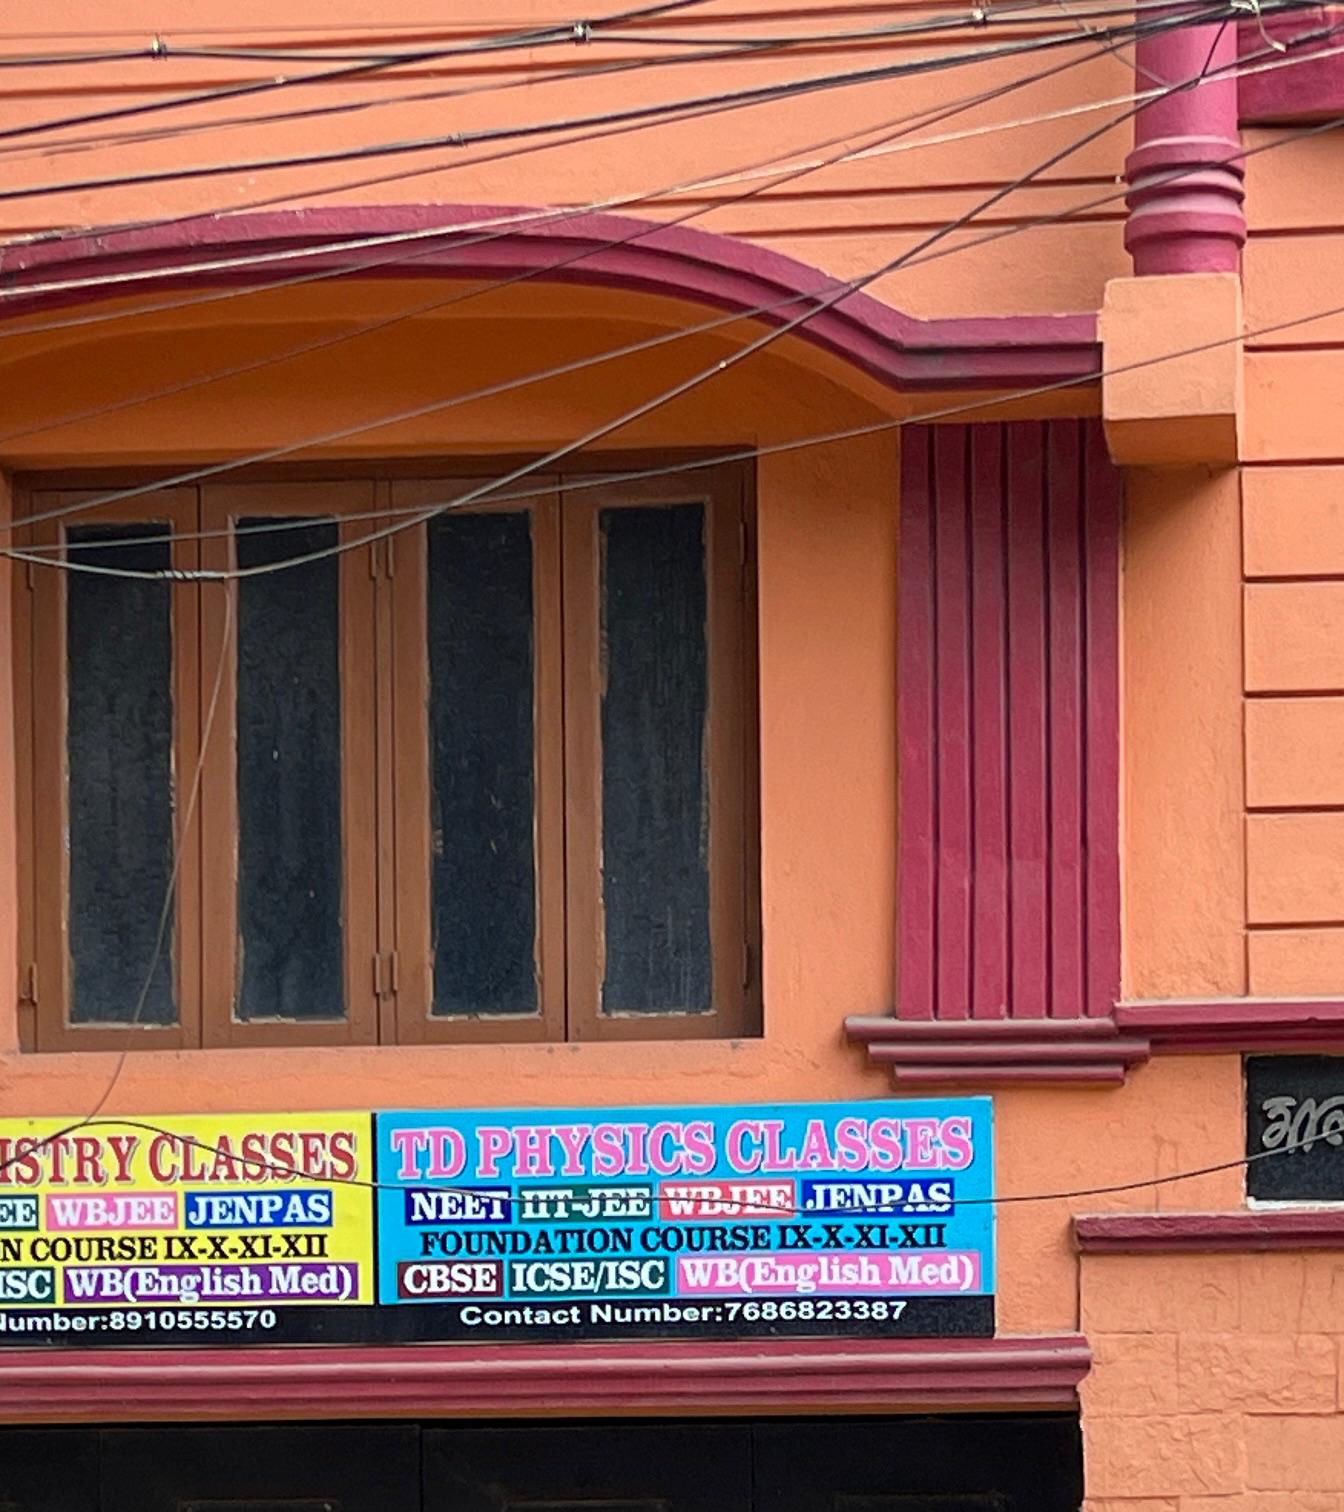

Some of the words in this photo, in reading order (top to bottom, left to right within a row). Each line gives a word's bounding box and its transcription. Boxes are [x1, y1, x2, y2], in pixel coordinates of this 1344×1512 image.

[149, 1130, 358, 1184] CLASSES
[391, 1129, 467, 1179] TD
[478, 1123, 716, 1178] PHYSICS
[726, 1116, 974, 1174] CLASSES
[50, 1196, 176, 1227] WBJEE
[188, 1194, 332, 1226] JENPAS
[411, 1189, 509, 1220] NEET
[521, 1187, 650, 1218] IIT-JEE
[665, 1184, 792, 1214] WBJEE
[805, 1182, 952, 1212] JENPAS
[31, 1236, 157, 1263] COURSE
[165, 1233, 328, 1260] IX-X-XI-XII
[420, 1228, 636, 1256] FOUNDATION
[641, 1225, 771, 1254] COURSE
[779, 1223, 947, 1250] IX-X-XI-XII
[66, 1266, 263, 1304] WB(English
[268, 1264, 353, 1300] Med)
[402, 1264, 498, 1294] CBSE
[511, 1260, 665, 1292] ICSE/ISC
[680, 1256, 884, 1293] WB(English
[888, 1255, 974, 1289] Med)
[460, 1305, 582, 1326] Contact
[590, 1300, 907, 1323] Number:7686823387
